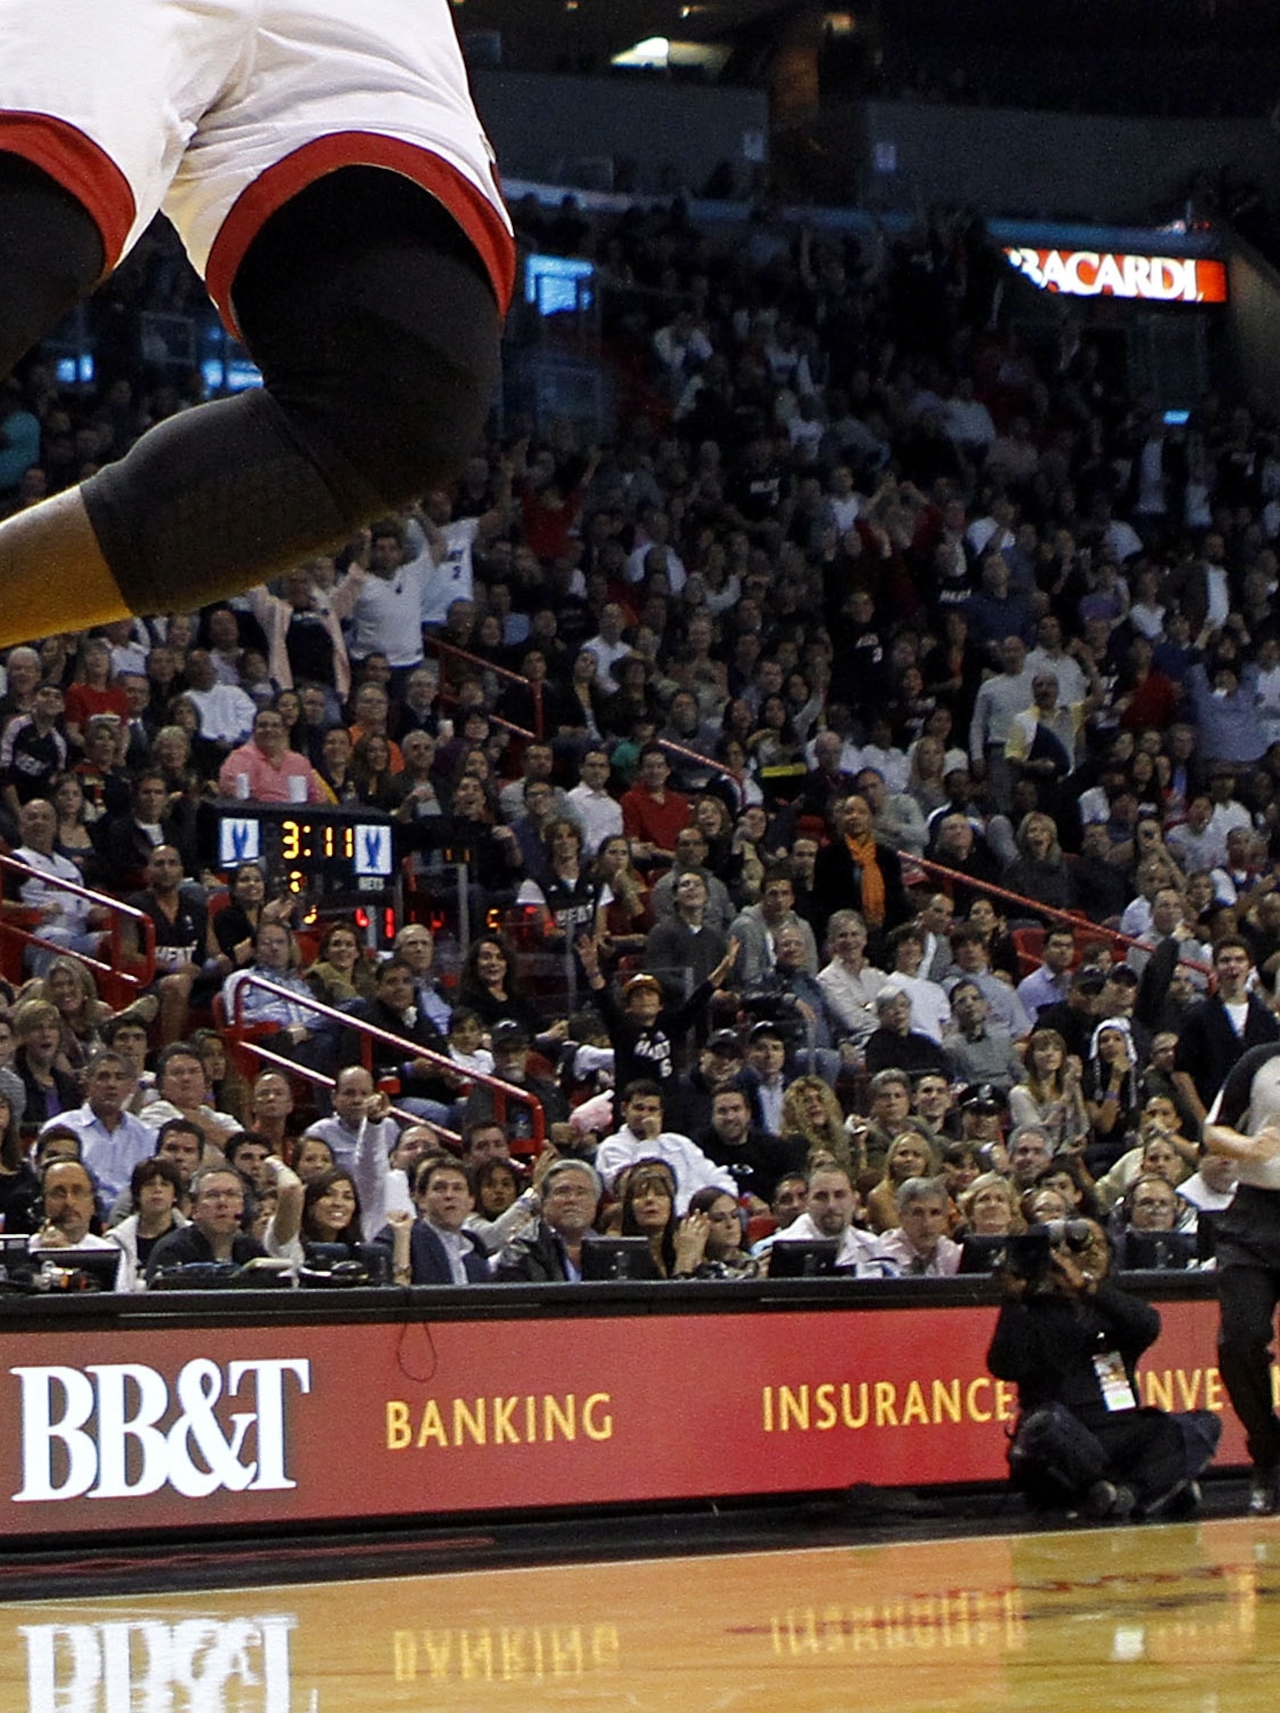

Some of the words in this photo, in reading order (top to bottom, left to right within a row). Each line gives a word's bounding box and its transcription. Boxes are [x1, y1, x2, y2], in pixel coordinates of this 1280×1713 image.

[1006, 247, 1199, 304] BACARDI
[282, 820, 354, 859] 3:11
[9, 1357, 311, 1503] BB&T
[387, 1392, 614, 1450] BANKING
[763, 1377, 1013, 1433] INSURANCE
